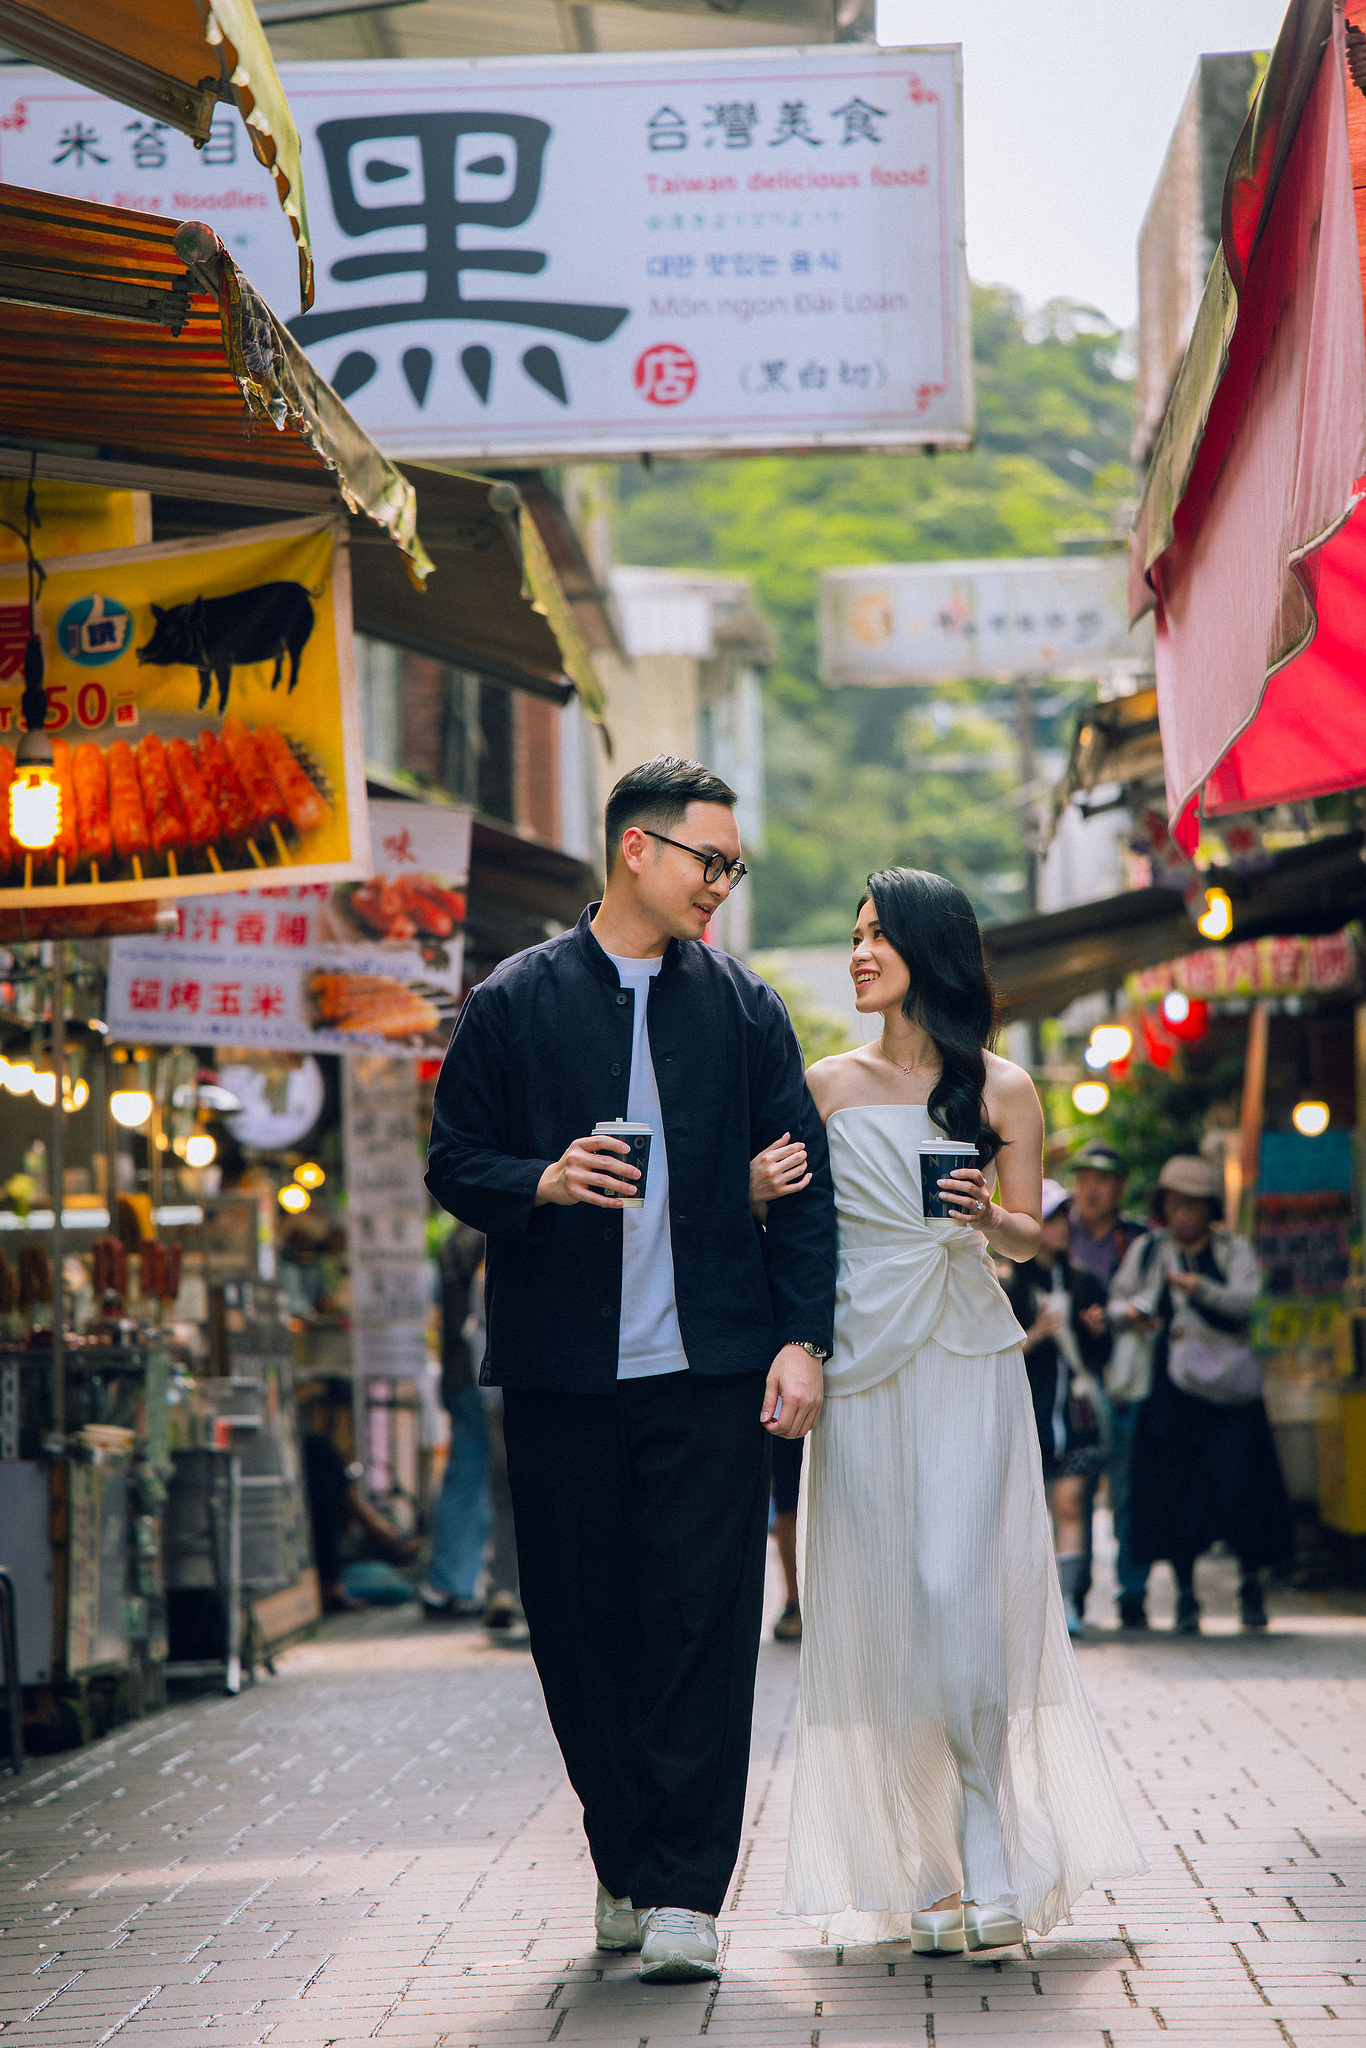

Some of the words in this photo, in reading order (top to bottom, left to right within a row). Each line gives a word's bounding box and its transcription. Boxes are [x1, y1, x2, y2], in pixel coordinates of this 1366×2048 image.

[51, 120, 238, 170] 米苔目
[648, 98, 889, 152] 台灣美食
[171, 188, 268, 210] Noodles
[646, 172, 736, 194] Taiwan
[748, 167, 860, 191] delicious
[871, 164, 930, 187] food
[284, 111, 632, 410] 黑
